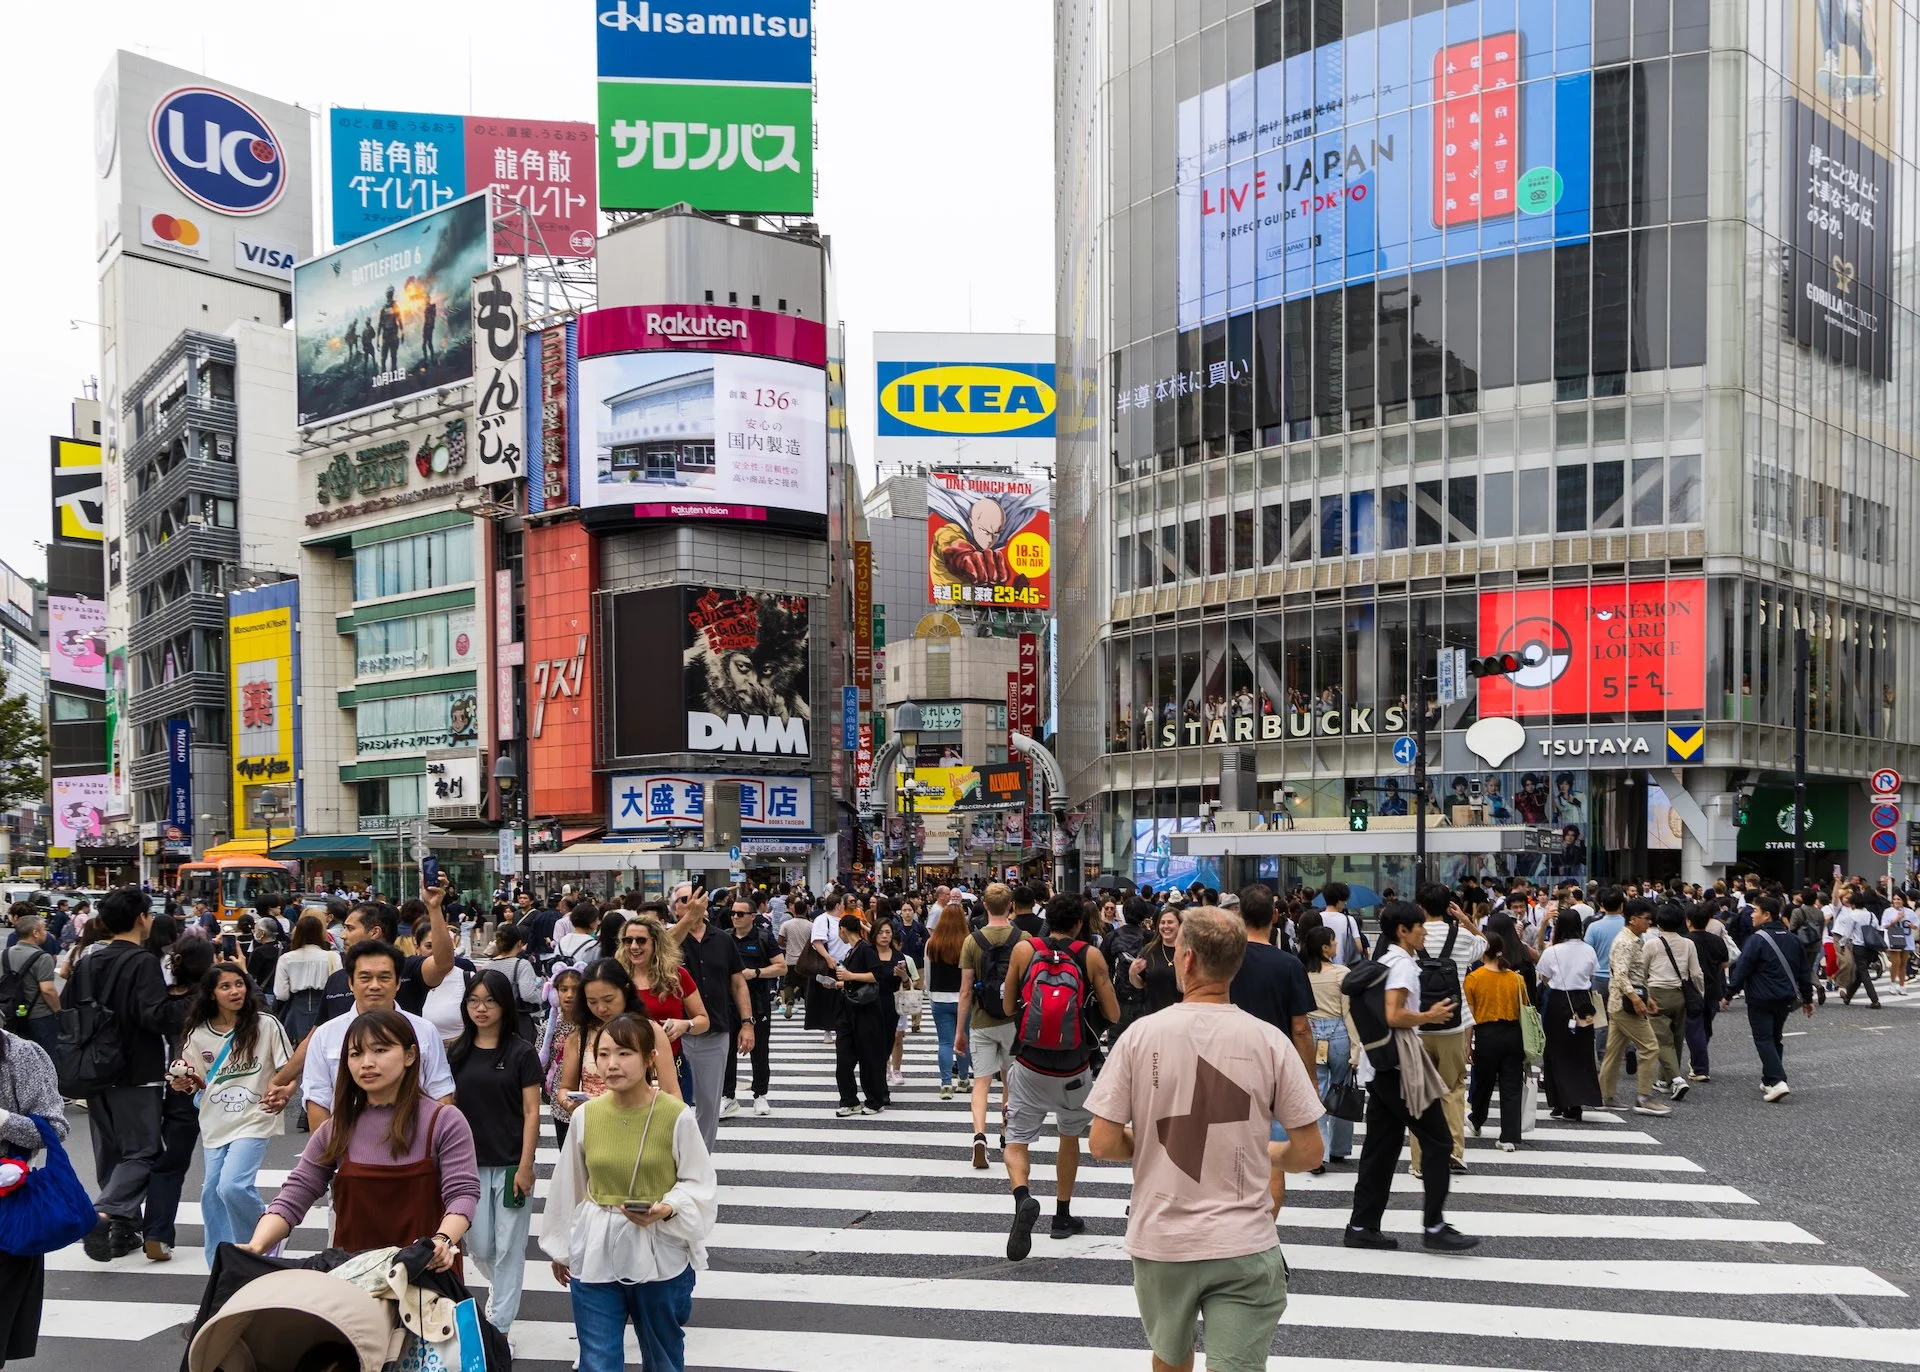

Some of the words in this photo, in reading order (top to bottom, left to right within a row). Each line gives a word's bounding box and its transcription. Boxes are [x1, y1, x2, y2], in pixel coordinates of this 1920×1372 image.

[599, 0, 808, 38] Hisamitsu
[339, 117, 456, 134] のど、直接、うるおう
[474, 124, 589, 142] のど、直接、うるおう
[358, 138, 439, 176] 龍角散
[610, 119, 801, 174] サロンパス
[493, 146, 572, 184] 龍角散
[1202, 170, 1266, 216] LIVE
[1277, 134, 1395, 193] JAPAN
[1300, 184, 1368, 217] TOKYO
[238, 240, 295, 271] VISA
[351, 251, 411, 287] BATTLEFIELD
[414, 246, 422, 266] 6
[646, 311, 748, 340] Rakuten
[477, 274, 521, 474] もんじゃ
[897, 384, 1046, 414] IKEA
[745, 418, 783, 432] 安心の
[728, 431, 801, 456] 国内製造
[945, 478, 966, 491] ONE
[968, 479, 1005, 493] PUNCH
[1007, 482, 1032, 495] MAN
[671, 505, 703, 515] Rakuten
[704, 506, 729, 516] Vision
[1016, 557, 1028, 567] ON
[1029, 558, 1044, 568] AIR
[857, 545, 870, 639] クスリのことなら
[933, 583, 972, 602] 毎週日曜
[974, 585, 993, 603] 深夜
[1607, 621, 1666, 640] CARD
[1594, 640, 1682, 660] LOUNGE
[1021, 642, 1035, 717] カラオケ
[242, 680, 273, 728] 薬
[928, 706, 962, 717] れいわ
[687, 711, 809, 755] DMM
[1162, 706, 1405, 748] STARBUCKS
[177, 727, 186, 763] MIZUHO
[1538, 736, 1650, 757] TSUTAYA
[620, 783, 798, 818] 大盛堂書店
[1765, 840, 1826, 849] STARBCKS
